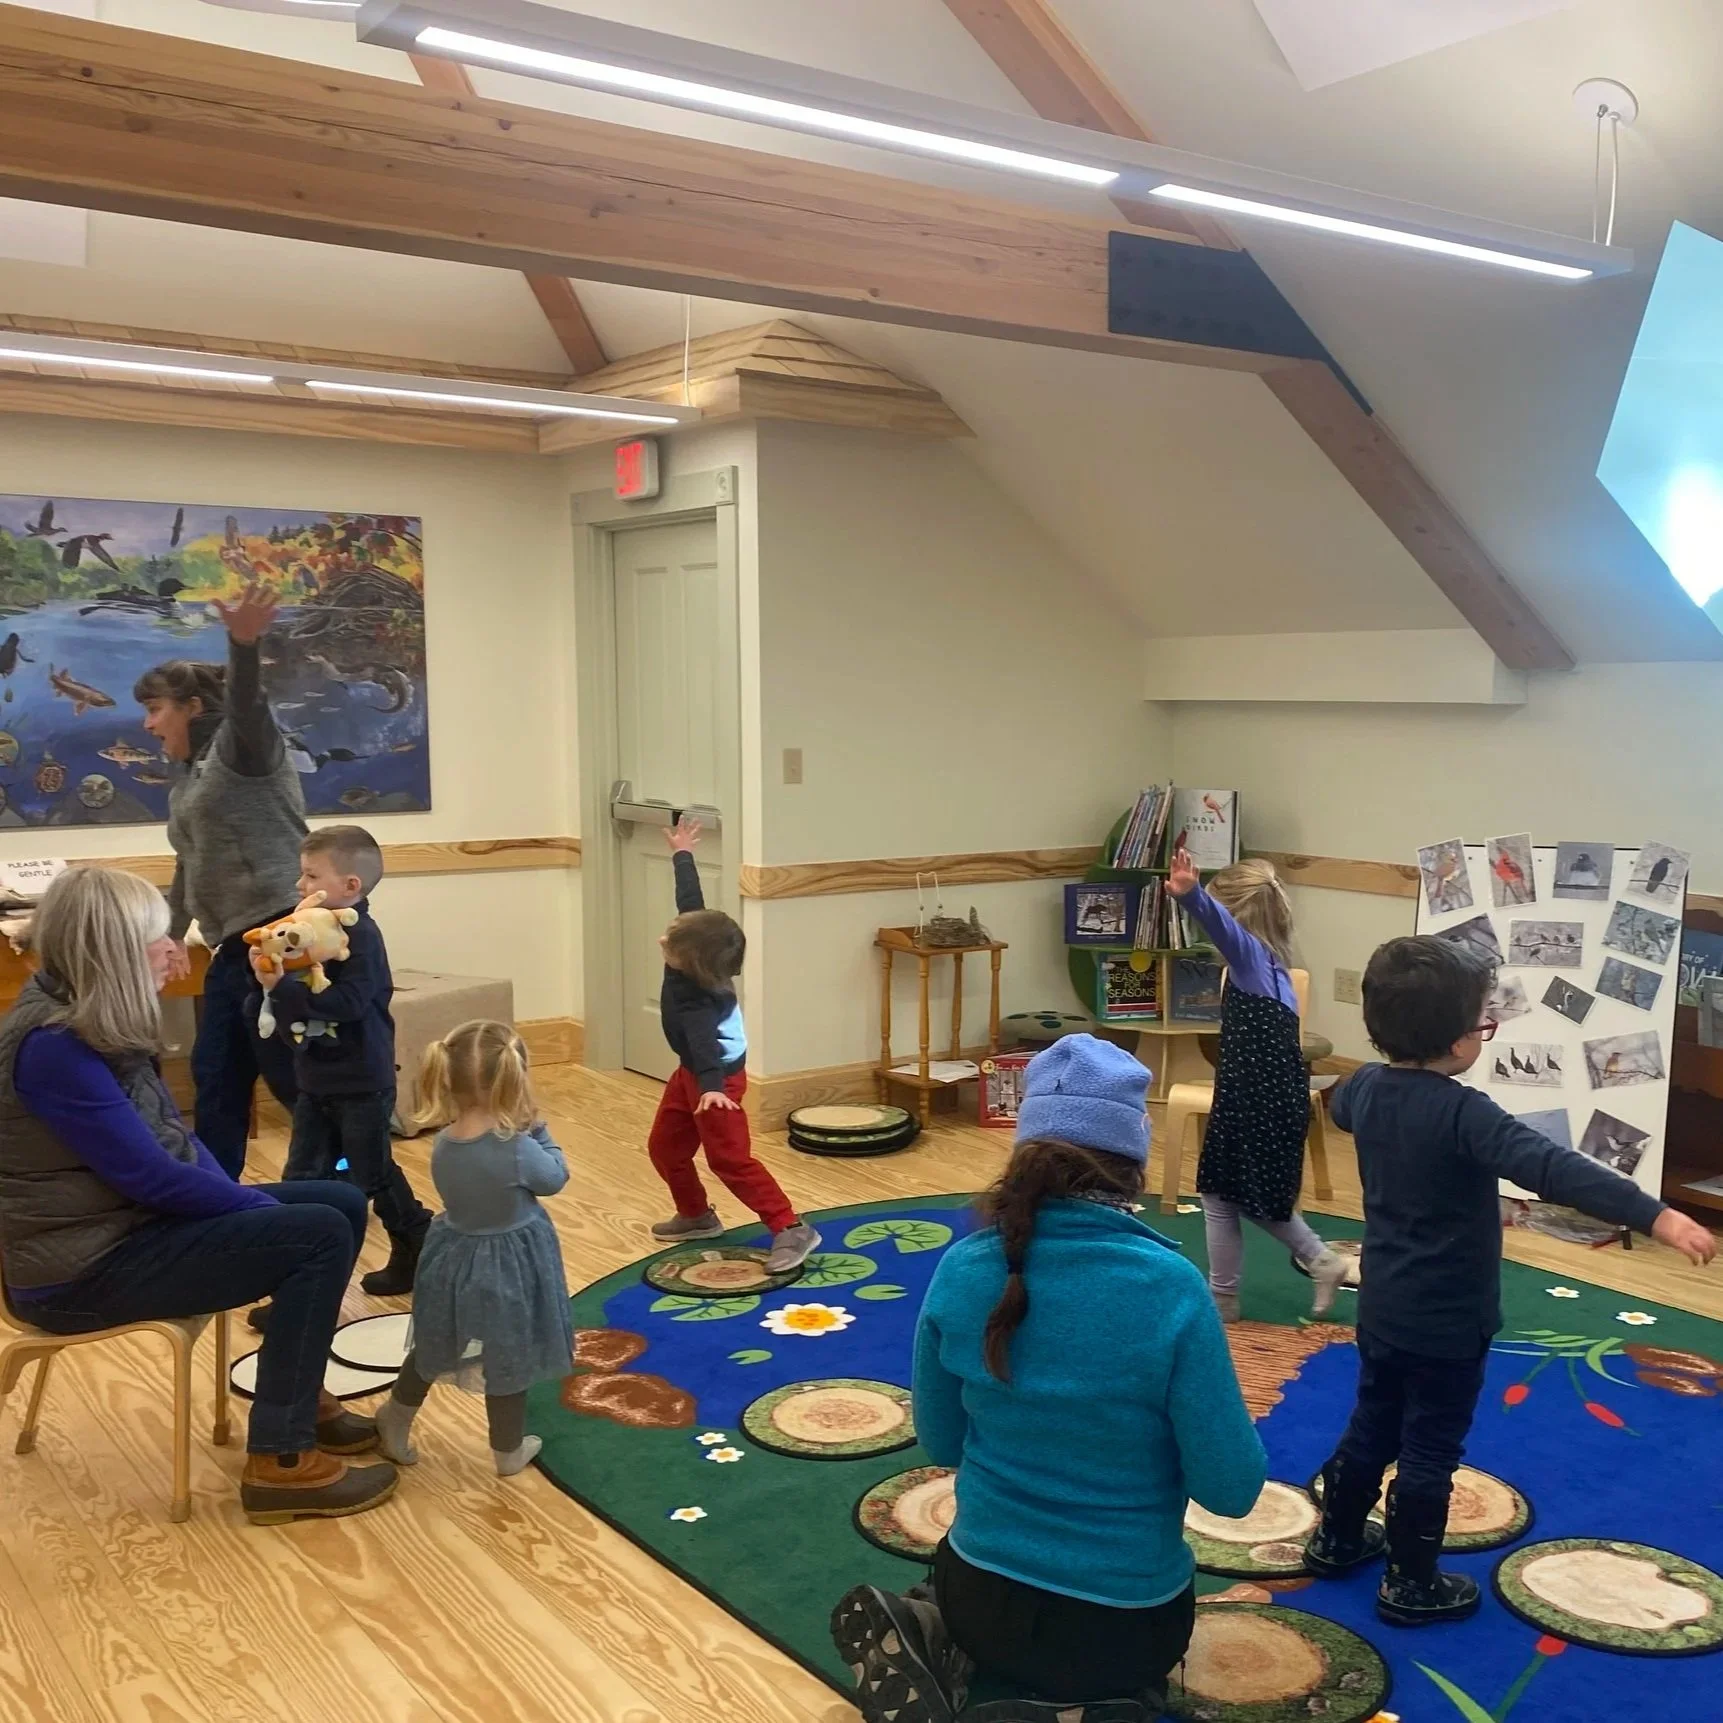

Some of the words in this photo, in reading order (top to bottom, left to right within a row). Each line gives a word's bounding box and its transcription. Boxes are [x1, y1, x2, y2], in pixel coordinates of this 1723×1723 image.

[18, 870, 53, 878] GENTLE
[1109, 972, 1156, 983] REASONS
[1108, 987, 1156, 999] SEASONS
